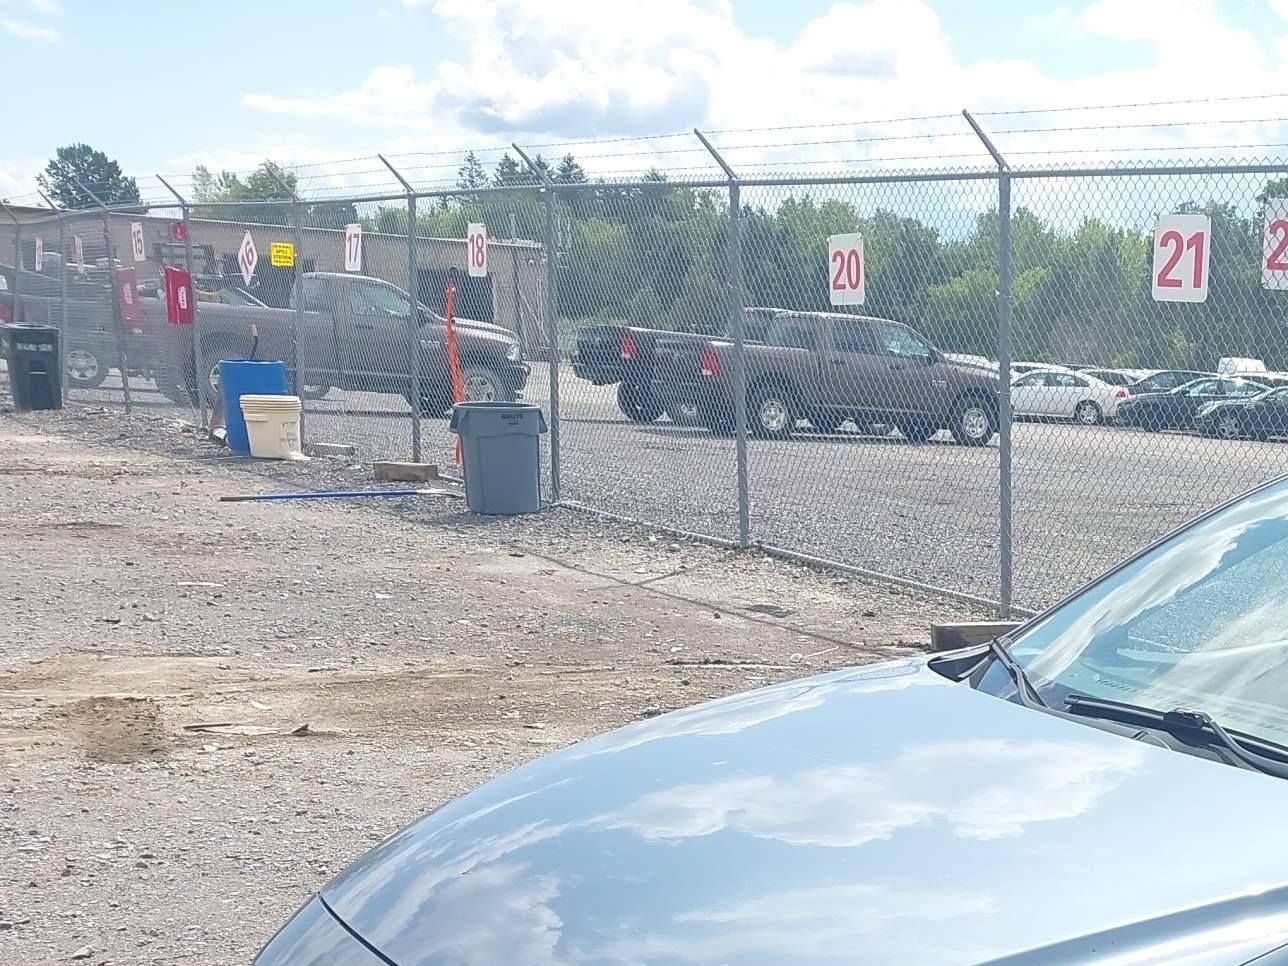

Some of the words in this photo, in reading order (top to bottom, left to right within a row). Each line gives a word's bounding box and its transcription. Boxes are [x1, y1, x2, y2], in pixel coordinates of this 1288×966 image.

[132, 230, 143, 256] 15
[241, 240, 255, 275] 16
[347, 233, 360, 263] 17
[469, 233, 485, 268] 18
[1157, 230, 1205, 289] 21
[832, 249, 861, 290] 20
